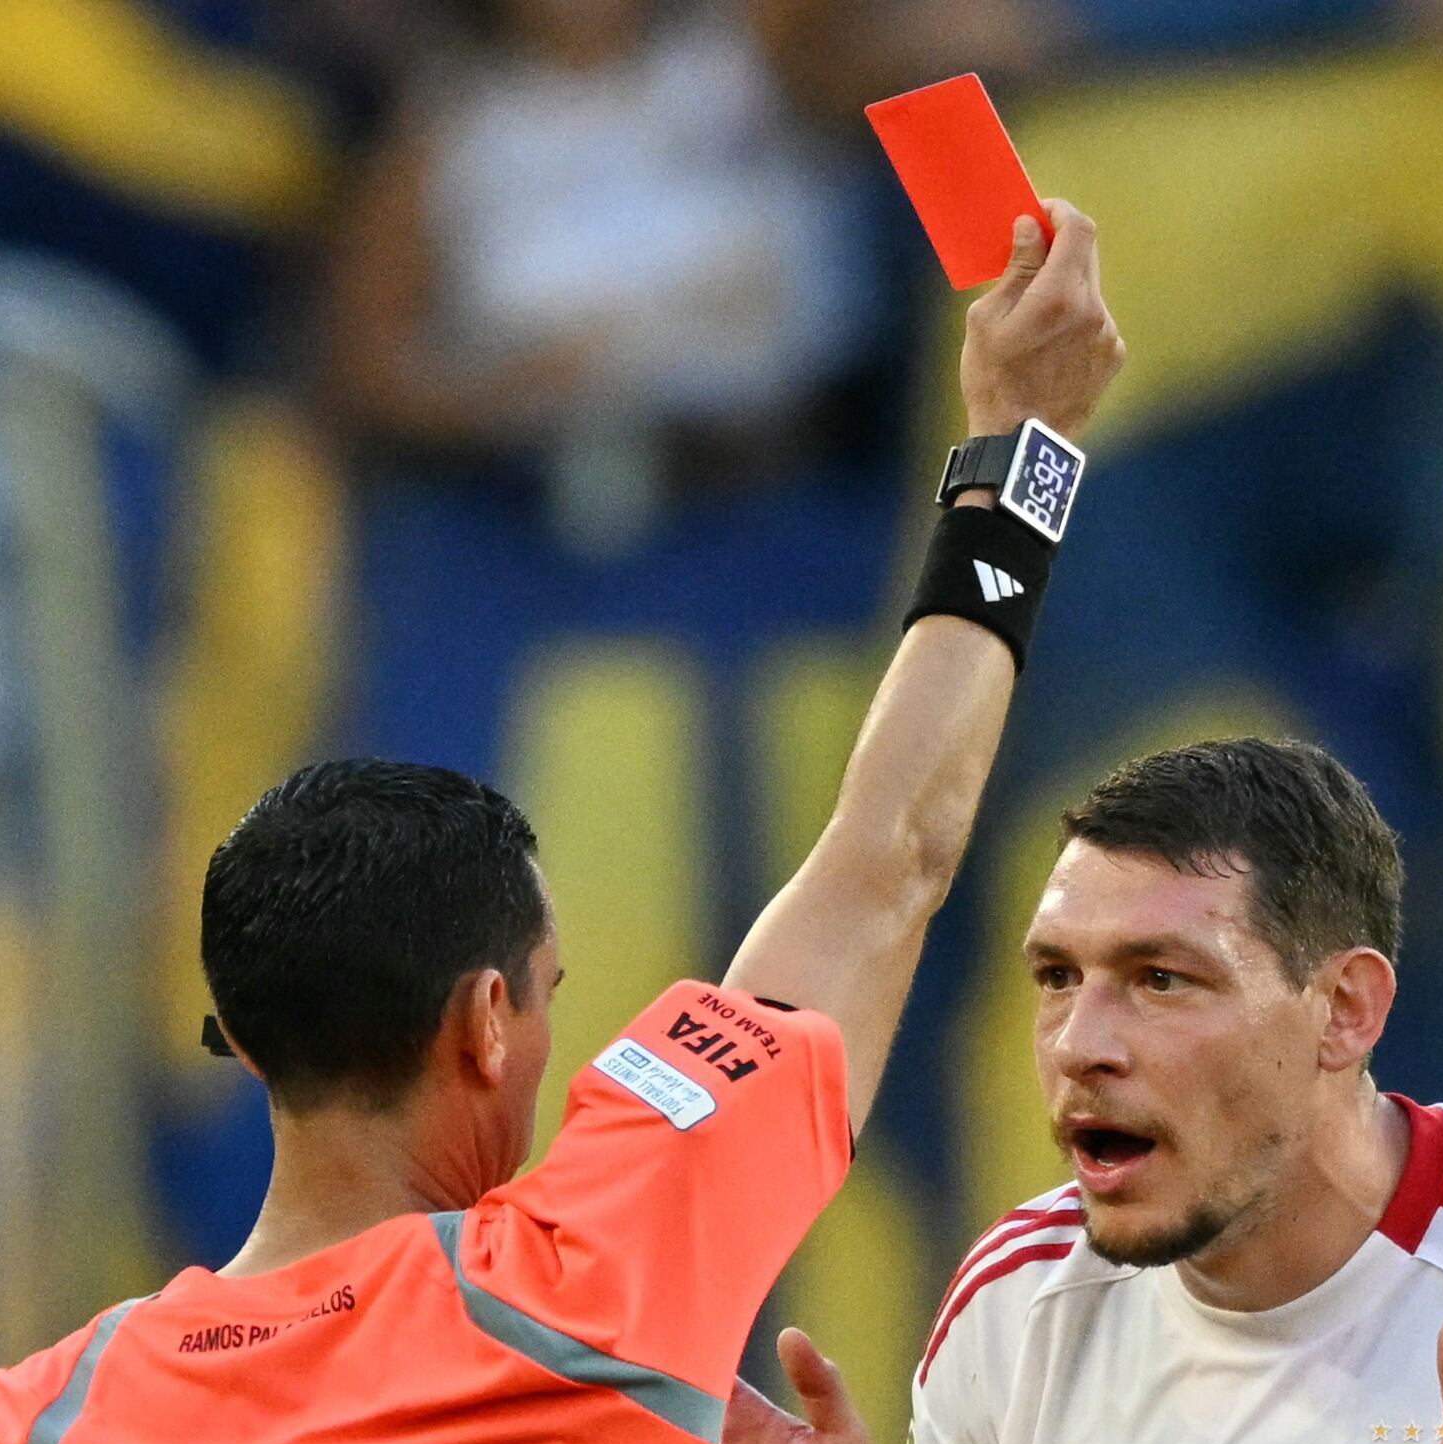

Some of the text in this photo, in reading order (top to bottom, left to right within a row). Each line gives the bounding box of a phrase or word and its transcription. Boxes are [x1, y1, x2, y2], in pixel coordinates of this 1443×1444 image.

[666, 1011, 759, 1083] FIFA
[696, 992, 781, 1060] TEAM ONE
[603, 1058, 685, 1116] FOOTBALL UNITES
[178, 1324, 245, 1353] RAMOS
